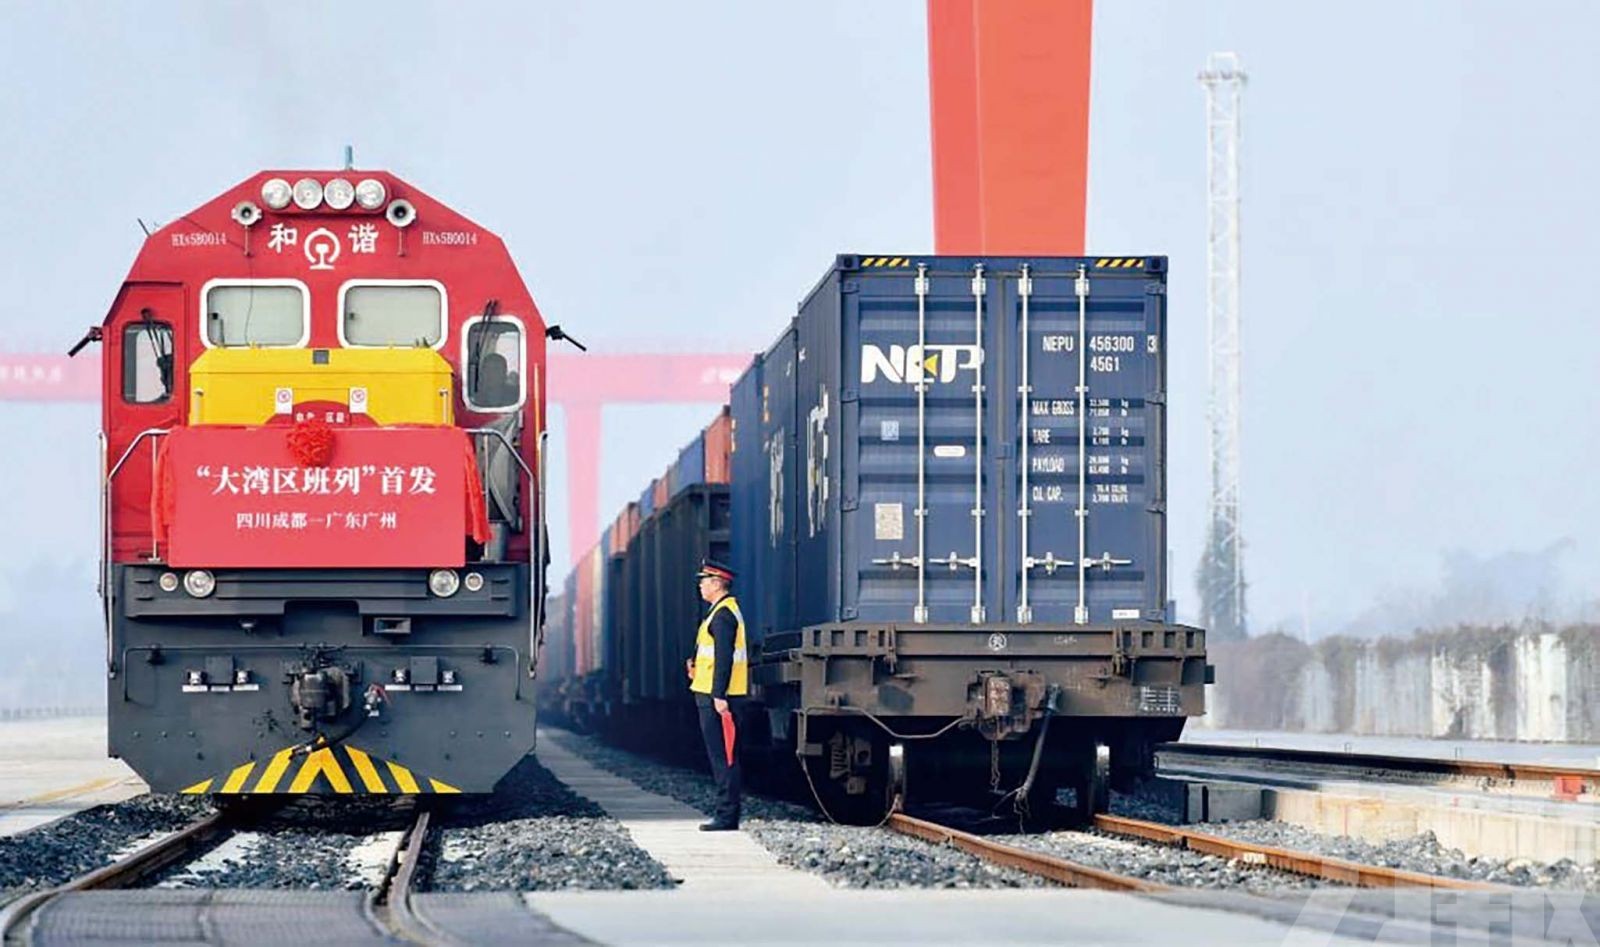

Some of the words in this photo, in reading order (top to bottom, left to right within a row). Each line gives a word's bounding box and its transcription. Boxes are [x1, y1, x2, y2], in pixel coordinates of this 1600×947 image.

[268, 223, 298, 254] 和
[348, 223, 379, 254] 谐
[1042, 336, 1074, 352] NEPU
[1089, 335, 1135, 352] 456300
[860, 344, 985, 384] NEP
[1090, 356, 1121, 372] 45G1
[1032, 456, 1065, 473] PAYLOAD
[196, 465, 437, 496] “大湾区班列”首发
